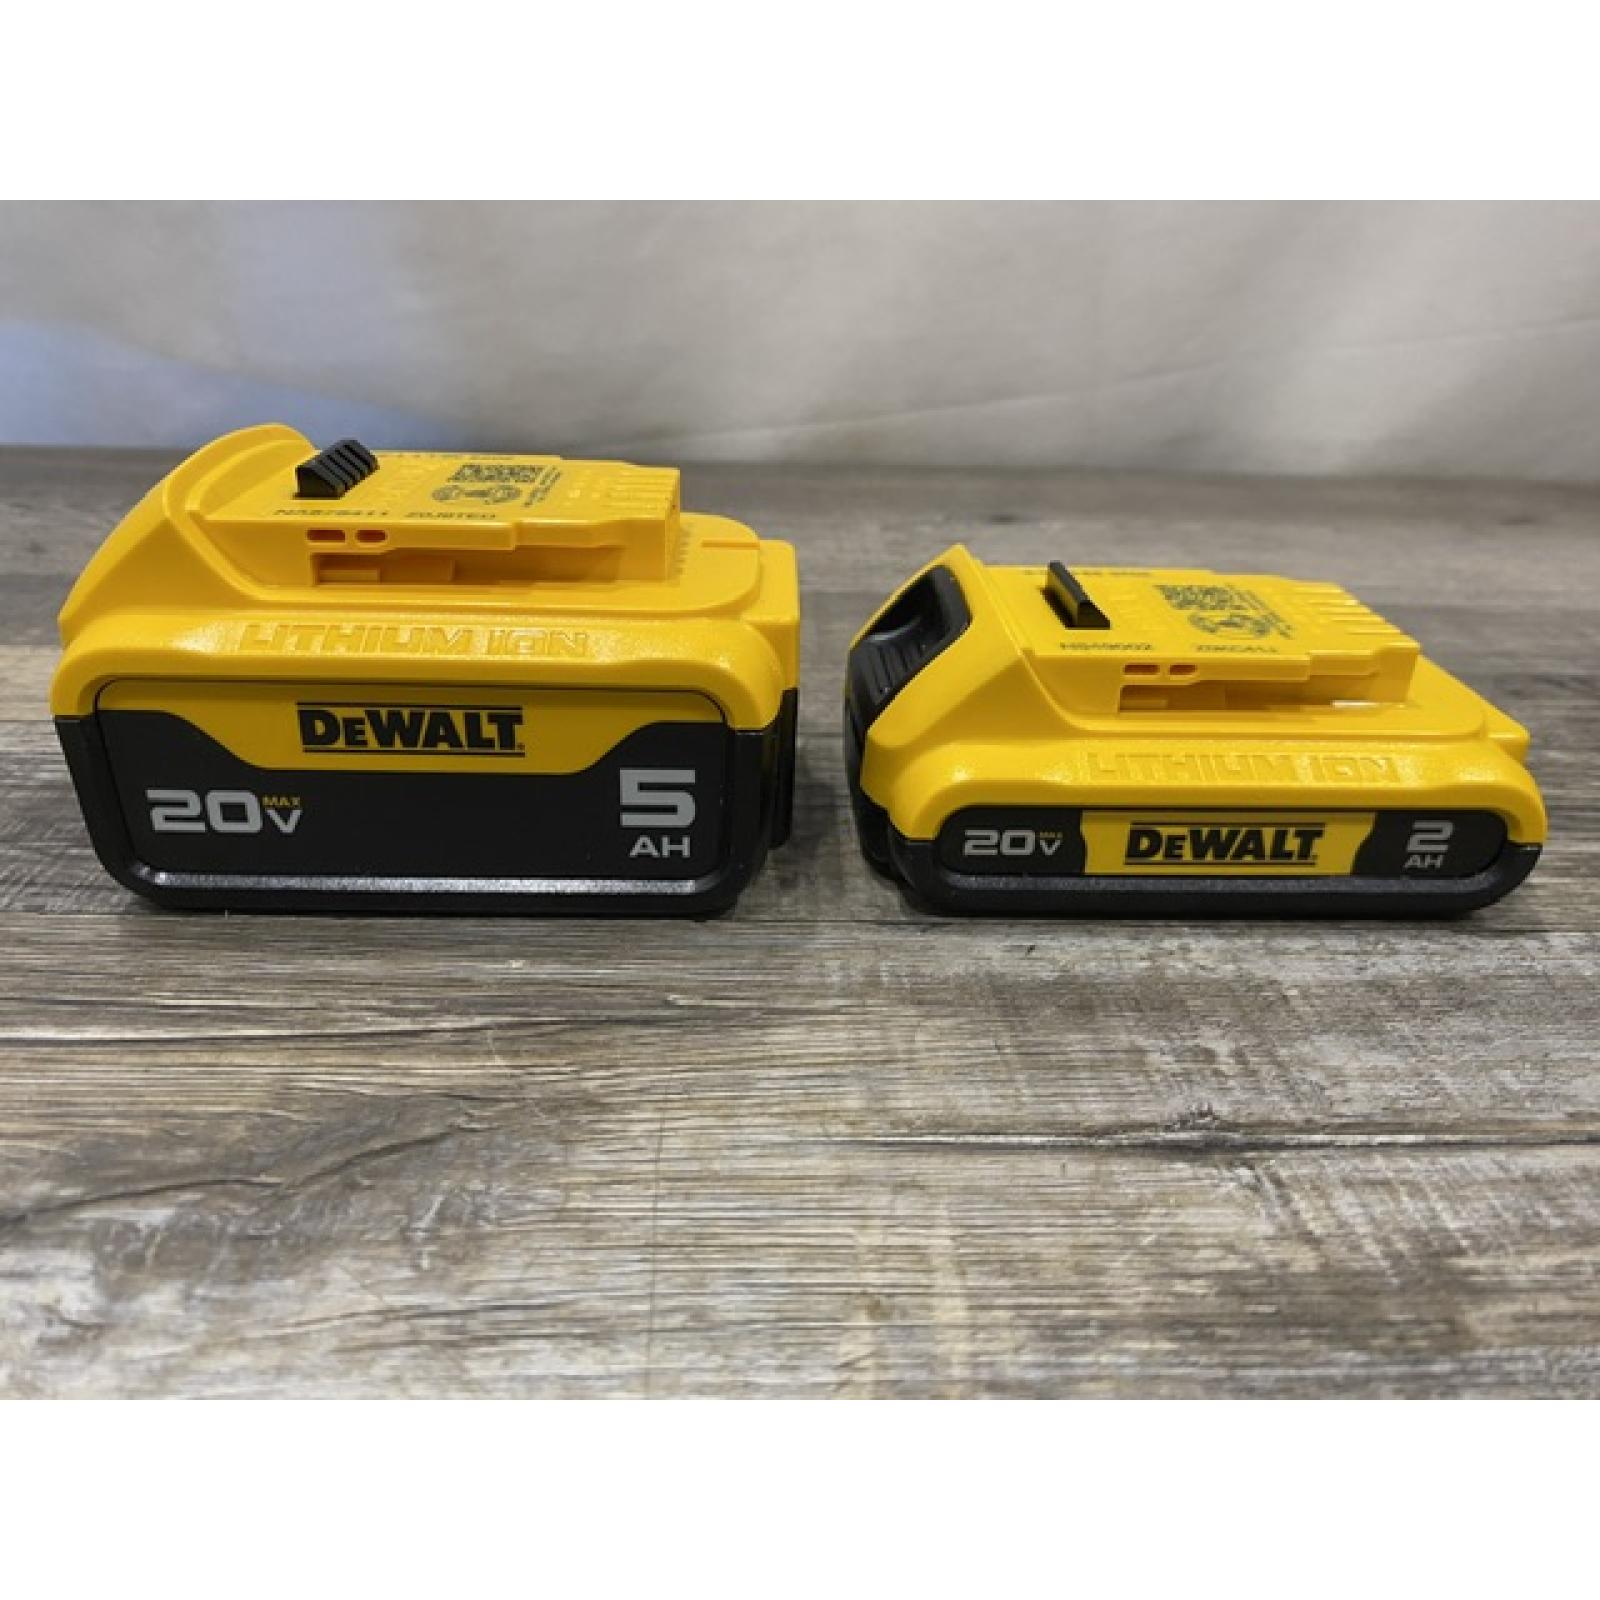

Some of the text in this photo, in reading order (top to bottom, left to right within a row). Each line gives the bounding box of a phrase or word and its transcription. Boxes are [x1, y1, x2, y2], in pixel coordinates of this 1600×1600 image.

[238, 624, 590, 658] LITHIUM ION
[297, 709, 524, 750] DEWALT
[1088, 752, 1400, 785] LITHIUM ION
[619, 769, 696, 828] 5
[629, 836, 691, 858] AH
[1126, 828, 1324, 861] DEWALT
[1408, 820, 1453, 853] 2
[1403, 854, 1443, 869] AH
